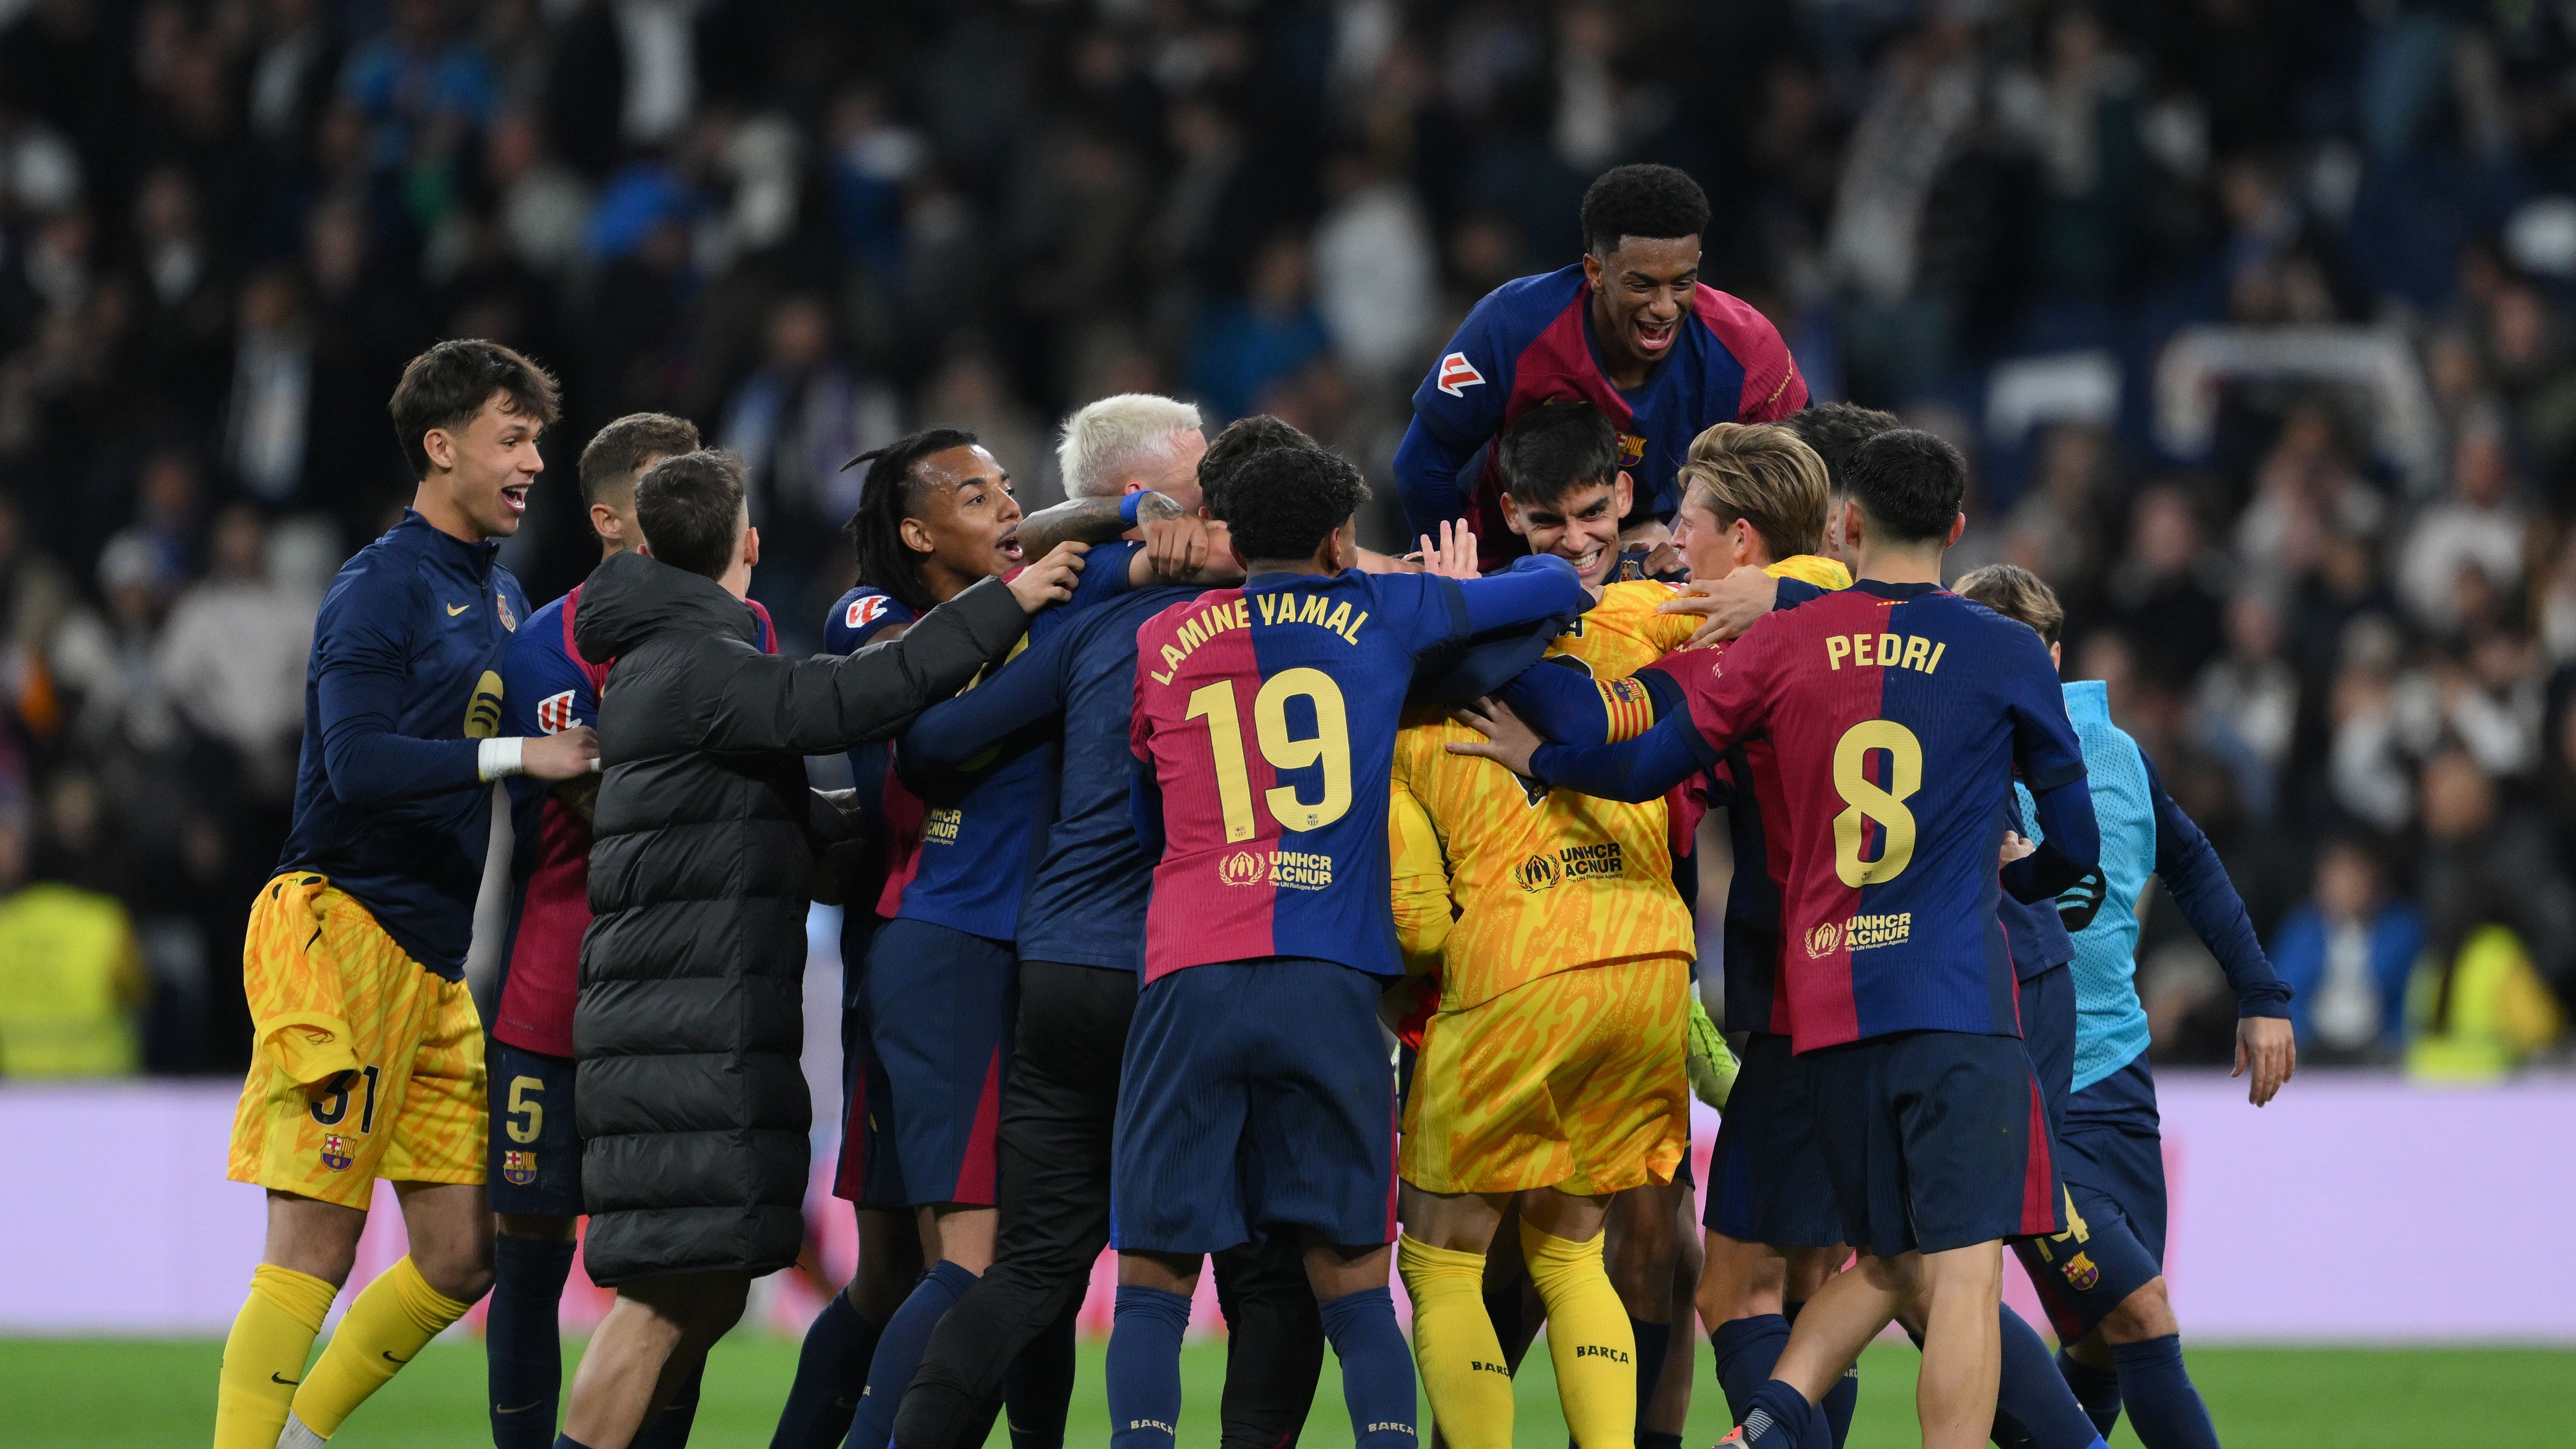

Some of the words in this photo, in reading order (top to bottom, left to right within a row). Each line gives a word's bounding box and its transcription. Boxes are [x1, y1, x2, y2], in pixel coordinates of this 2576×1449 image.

[1151, 597, 1252, 686] LAMINE
[1256, 593, 1368, 646] YAMAL
[1825, 633, 1946, 675] PEDRI
[1184, 667, 1353, 844] 19
[1832, 719, 1923, 889] 8
[931, 809, 962, 825] NHCR
[1269, 851, 1331, 871] UNHCR
[1560, 843, 1621, 862] UNHCR
[1268, 866, 1332, 885] ACNUR
[1566, 858, 1623, 877] ACNUR
[1845, 912, 1911, 931] UNHCR
[1844, 925, 1910, 946] ACNUR
[1888, 938, 1909, 946] Agency
[310, 1065, 380, 1134] 31
[506, 1075, 545, 1144] 5
[1576, 1345, 1629, 1364] BARÇA
[1130, 1419, 1173, 1436] BARÇA
[1368, 1422, 1414, 1436] BARÇA
